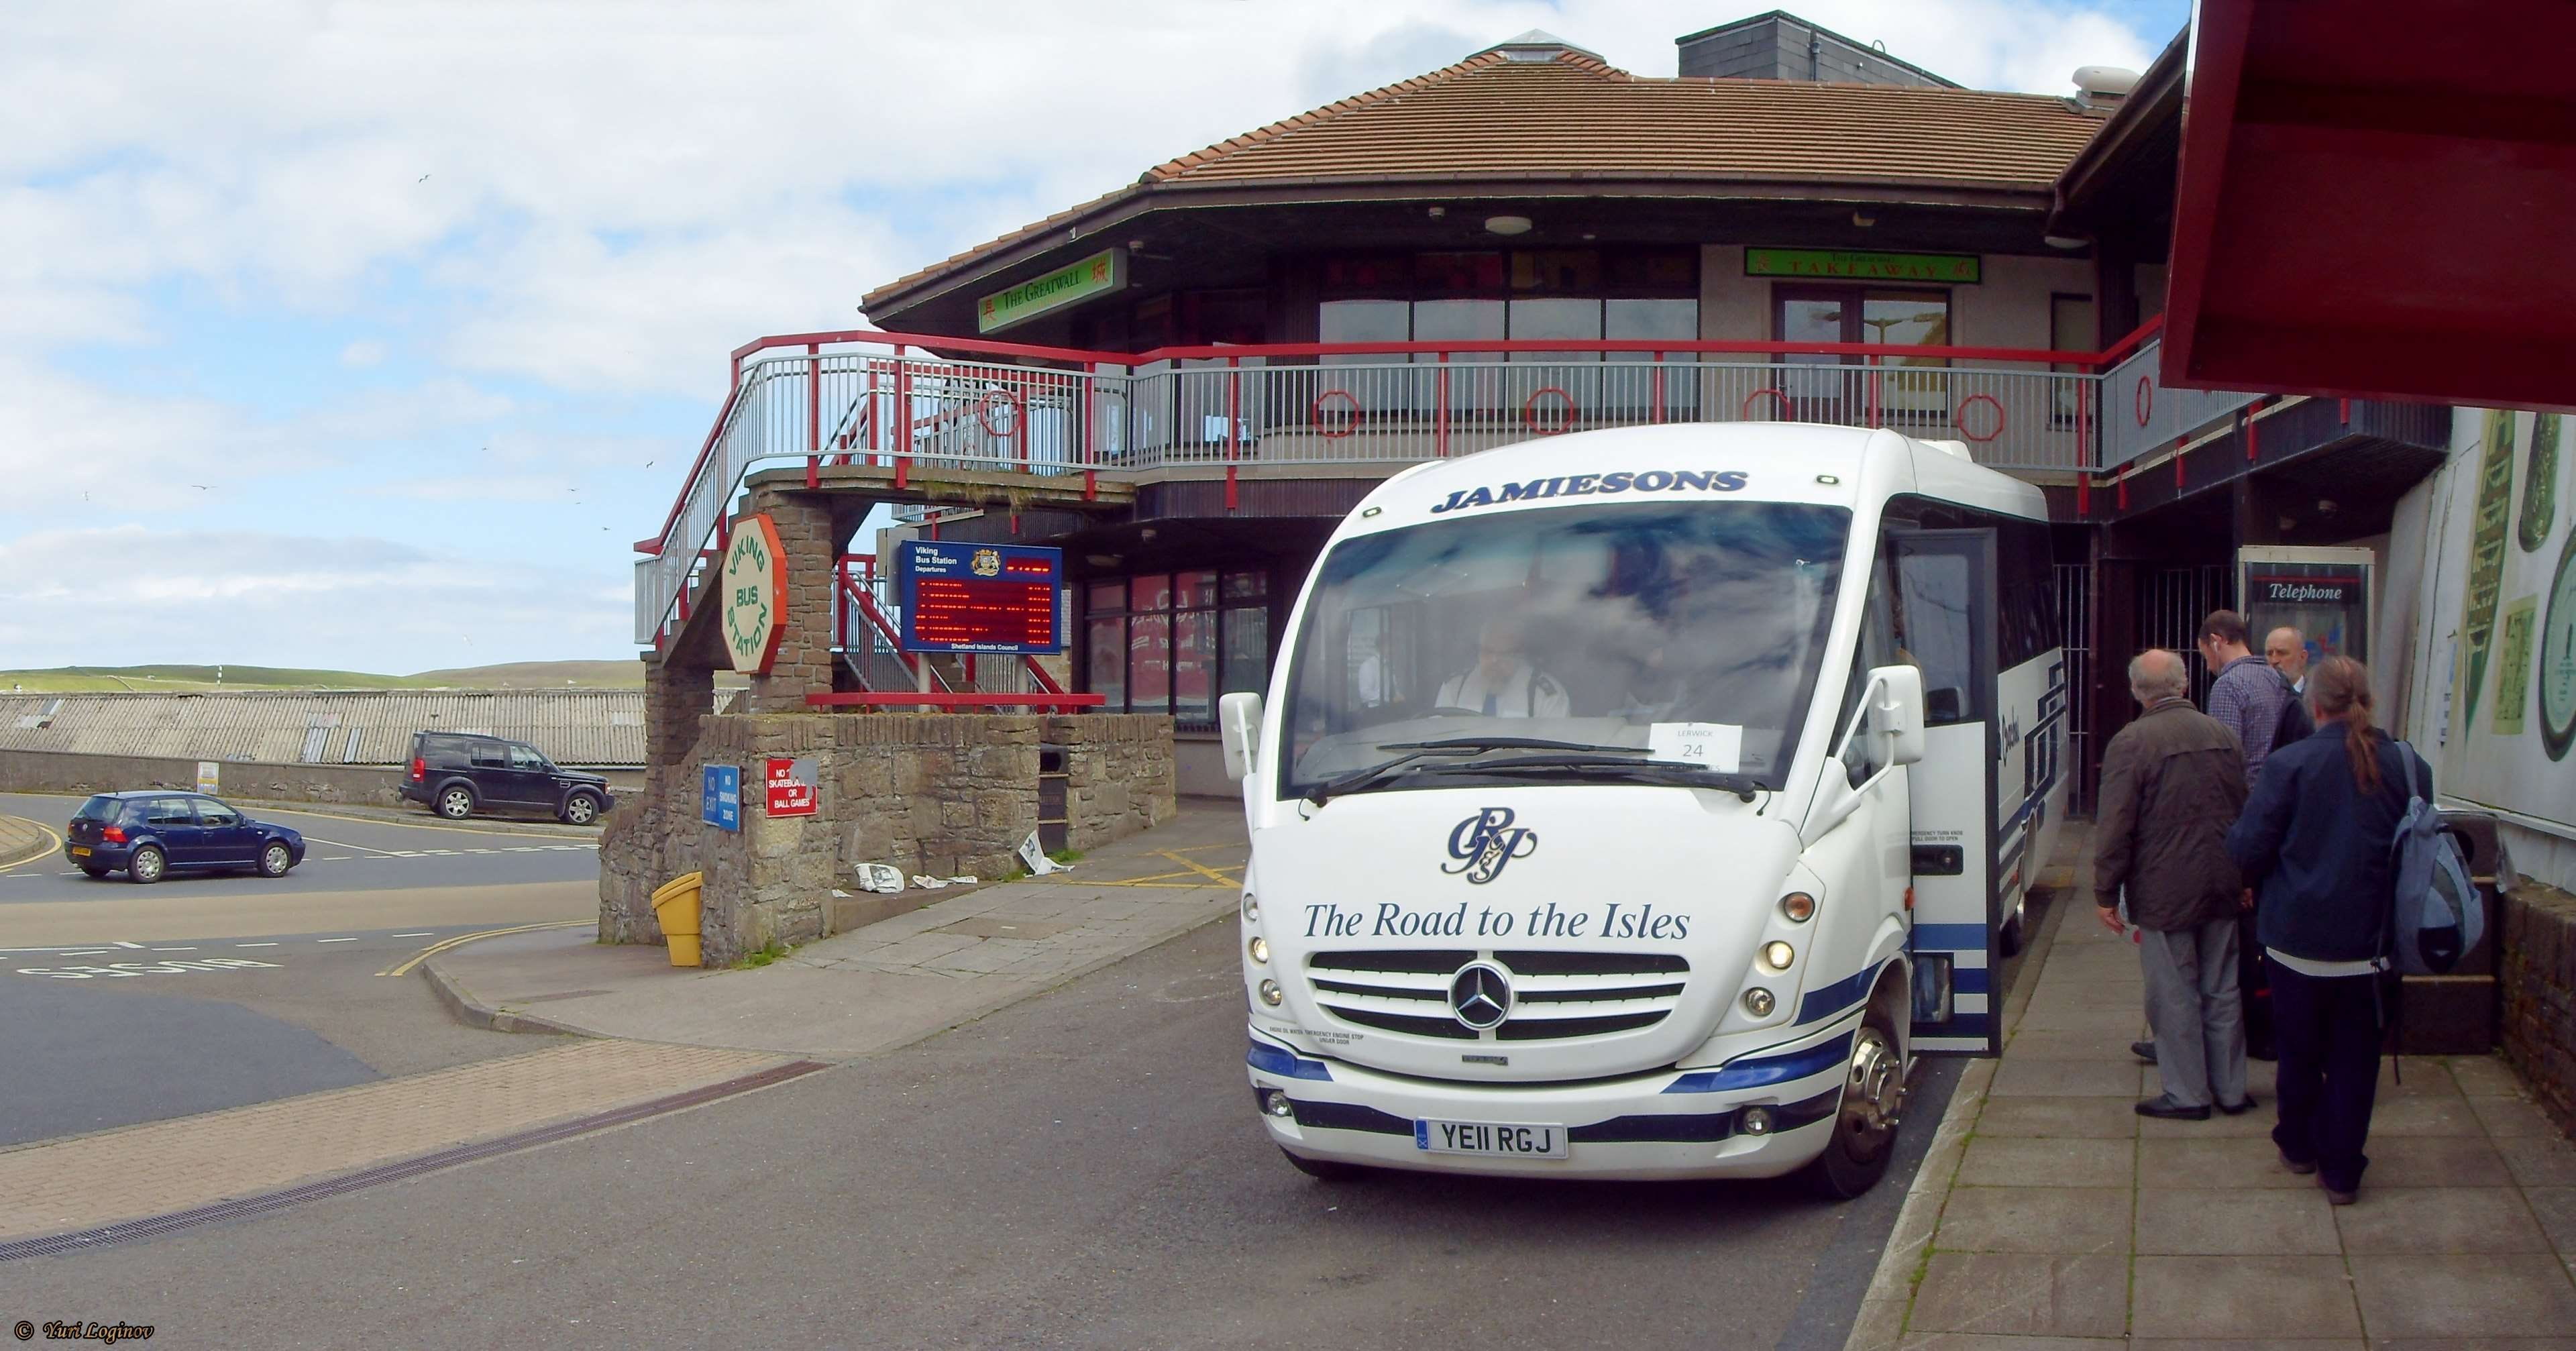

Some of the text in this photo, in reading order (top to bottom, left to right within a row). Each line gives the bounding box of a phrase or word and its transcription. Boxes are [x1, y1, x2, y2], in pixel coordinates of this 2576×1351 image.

[1788, 261, 1936, 277] TAKEAWAY
[1430, 470, 1749, 514] JAMIESONS
[729, 535, 765, 576] VIKING
[915, 546, 938, 556] Viking
[932, 557, 957, 565] Station
[737, 586, 758, 607] BUS
[2269, 583, 2342, 601] Telephone
[727, 602, 767, 657] STATION
[1683, 745, 1703, 757] 24
[776, 769, 786, 777] NO
[788, 789, 798, 798] OR
[774, 798, 810, 808] BALL GAMES
[1304, 902, 1691, 940] The Road to the Isles
[1497, 1127, 1551, 1153] RGJ
